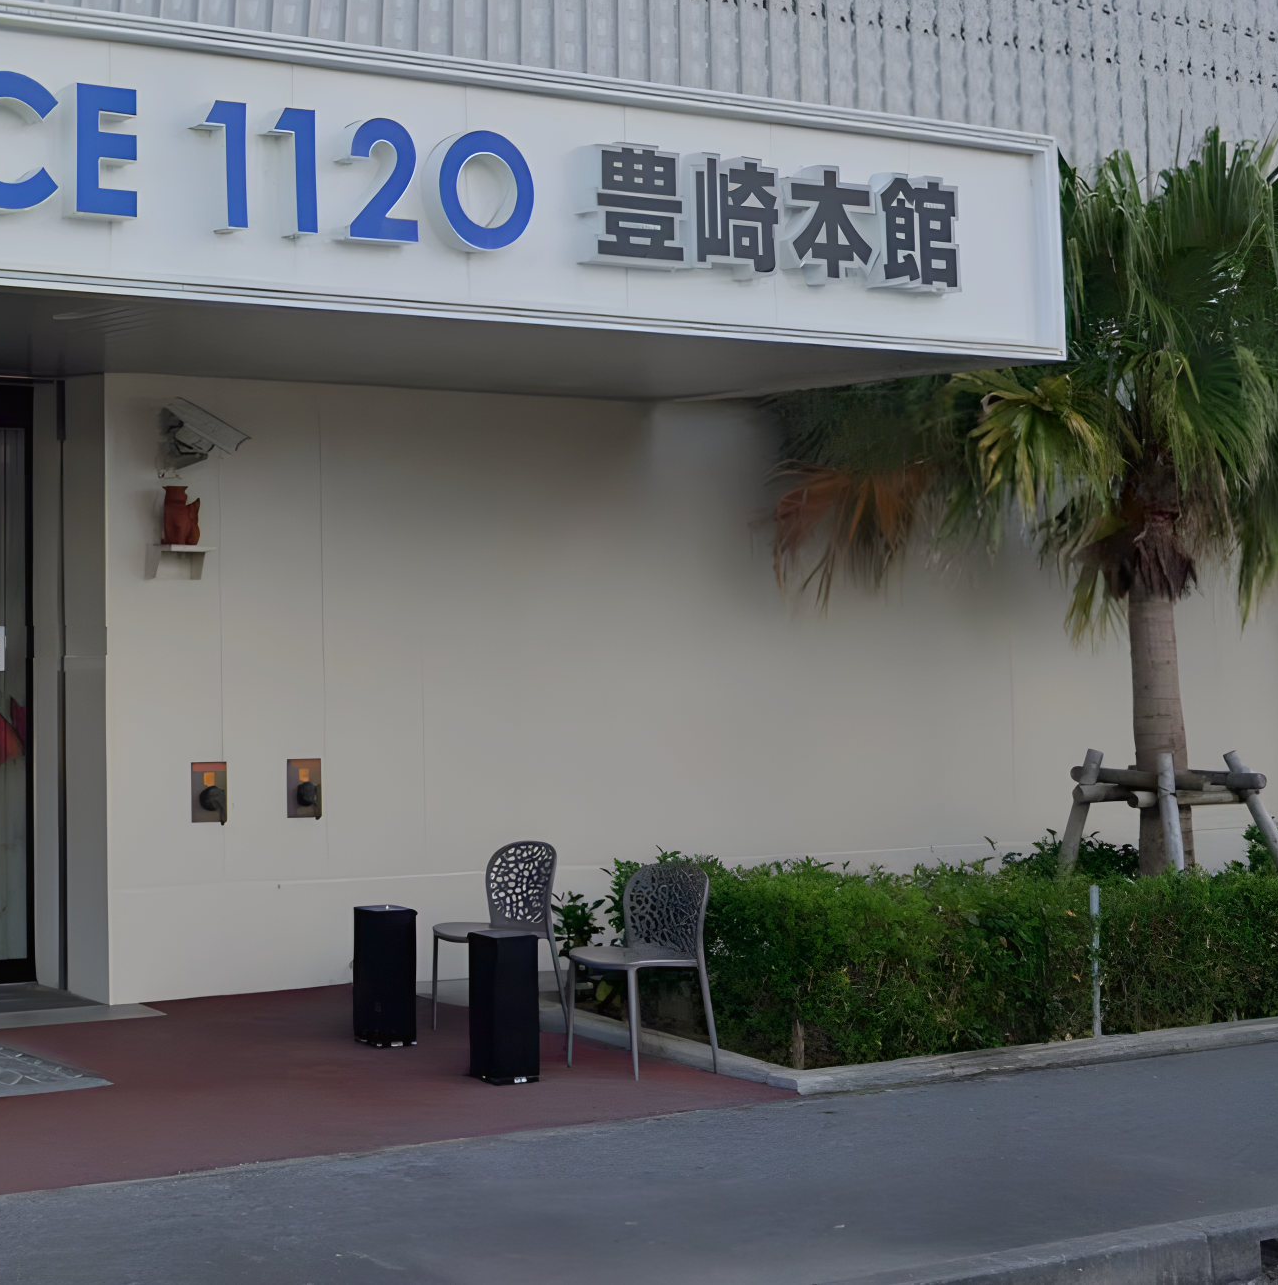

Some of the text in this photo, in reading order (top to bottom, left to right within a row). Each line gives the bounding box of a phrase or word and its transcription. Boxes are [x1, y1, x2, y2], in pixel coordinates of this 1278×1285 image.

[204, 100, 535, 250] 1120
[595, 144, 960, 289] 豊崎本館
